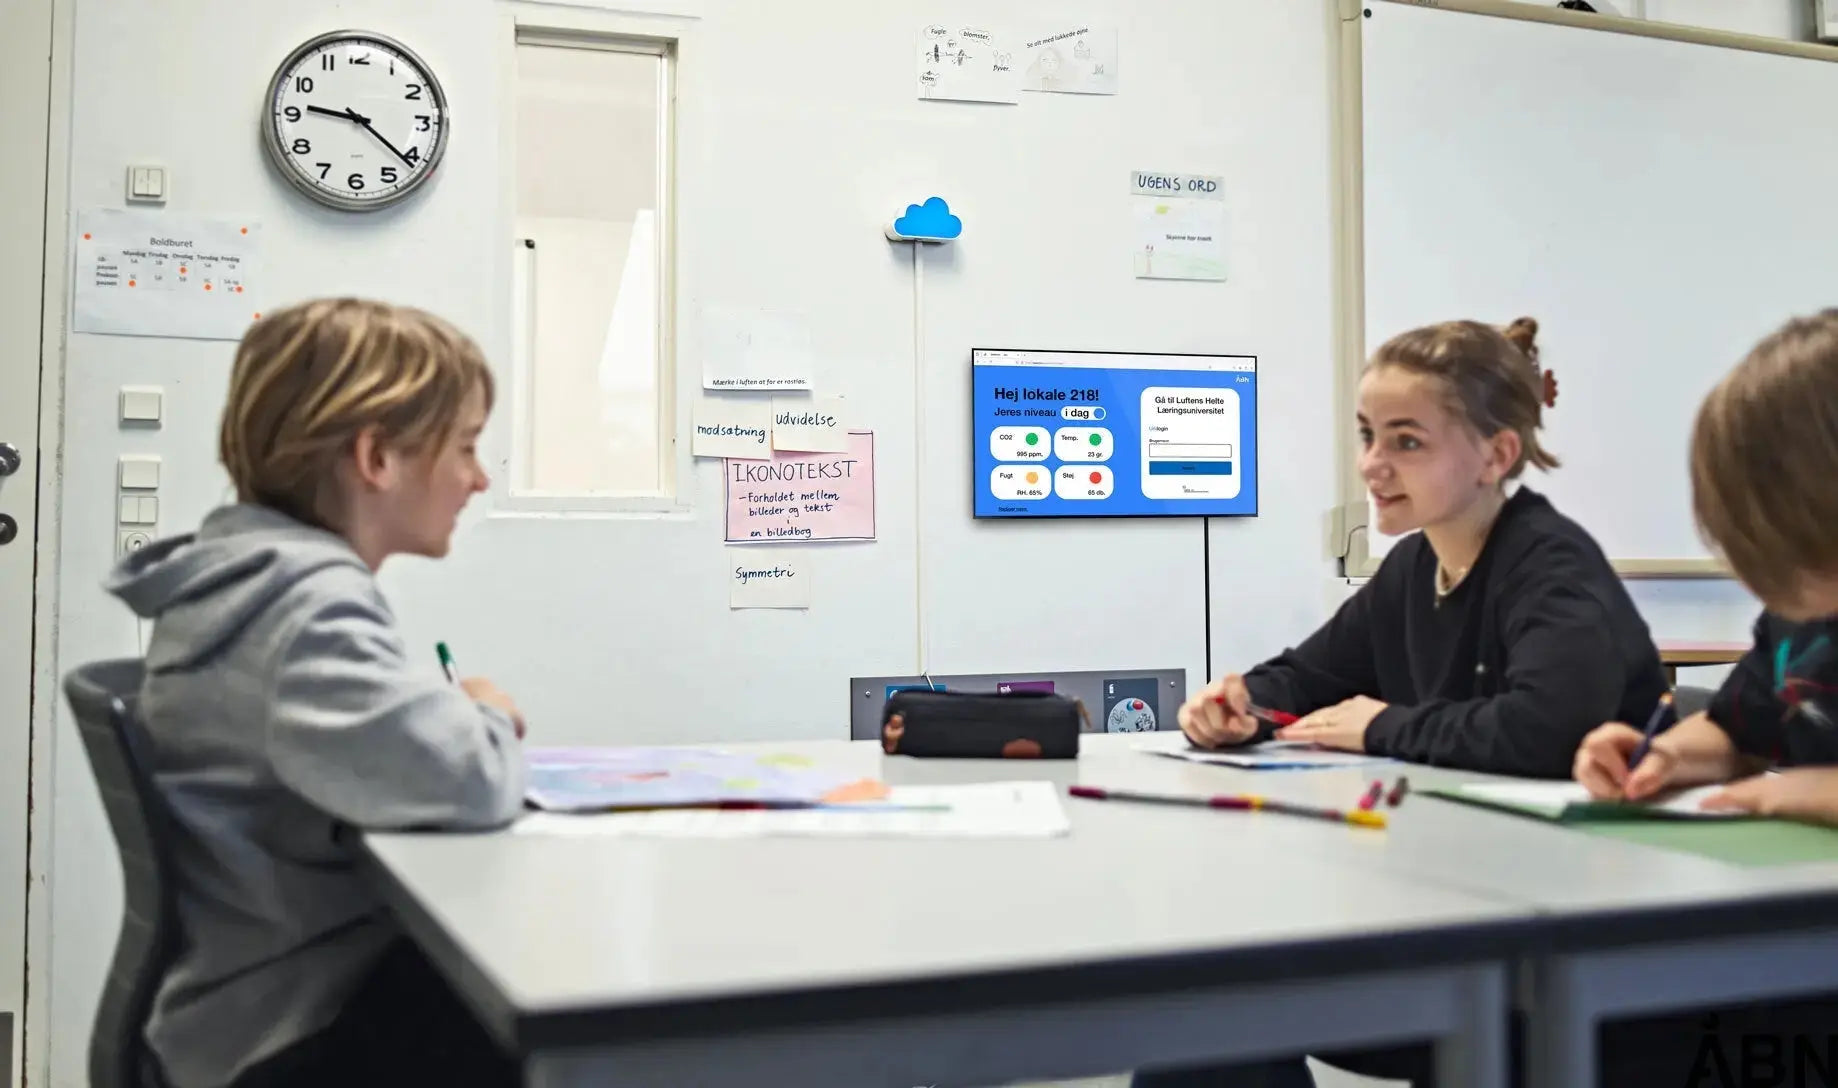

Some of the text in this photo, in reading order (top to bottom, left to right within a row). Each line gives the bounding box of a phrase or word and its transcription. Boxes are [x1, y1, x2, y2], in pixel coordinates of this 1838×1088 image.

[1042, 36, 1054, 44] med
[1055, 31, 1075, 41] lukkede
[322, 54, 334, 71] 11
[296, 76, 314, 93] 10
[405, 84, 421, 100] 2
[284, 106, 302, 122] 9
[414, 115, 431, 132] 3
[292, 138, 311, 154] 8
[402, 146, 420, 163] 4
[316, 163, 332, 179] 7
[381, 167, 397, 183] 5
[348, 173, 365, 190] 6
[1138, 174, 1216, 192] UGENS ORD
[150, 237, 193, 248] Boldburet
[994, 387, 1099, 402] Hej lokale 218!
[1154, 396, 1166, 404] Gå
[994, 407, 1057, 417] Jeres niveau
[1064, 408, 1089, 419] i dag
[1157, 406, 1224, 415] Læringsuniversitet
[776, 411, 837, 427] udvidelse
[1061, 434, 1079, 442] Temp.
[732, 460, 858, 483] IKONOTEKST
[999, 472, 1013, 480] Fugt
[1062, 472, 1074, 480] Støj
[800, 490, 840, 501] mellem
[749, 503, 833, 518] billeder og tekst
[767, 527, 812, 539] billedbog
[735, 564, 795, 584] Symmetri
